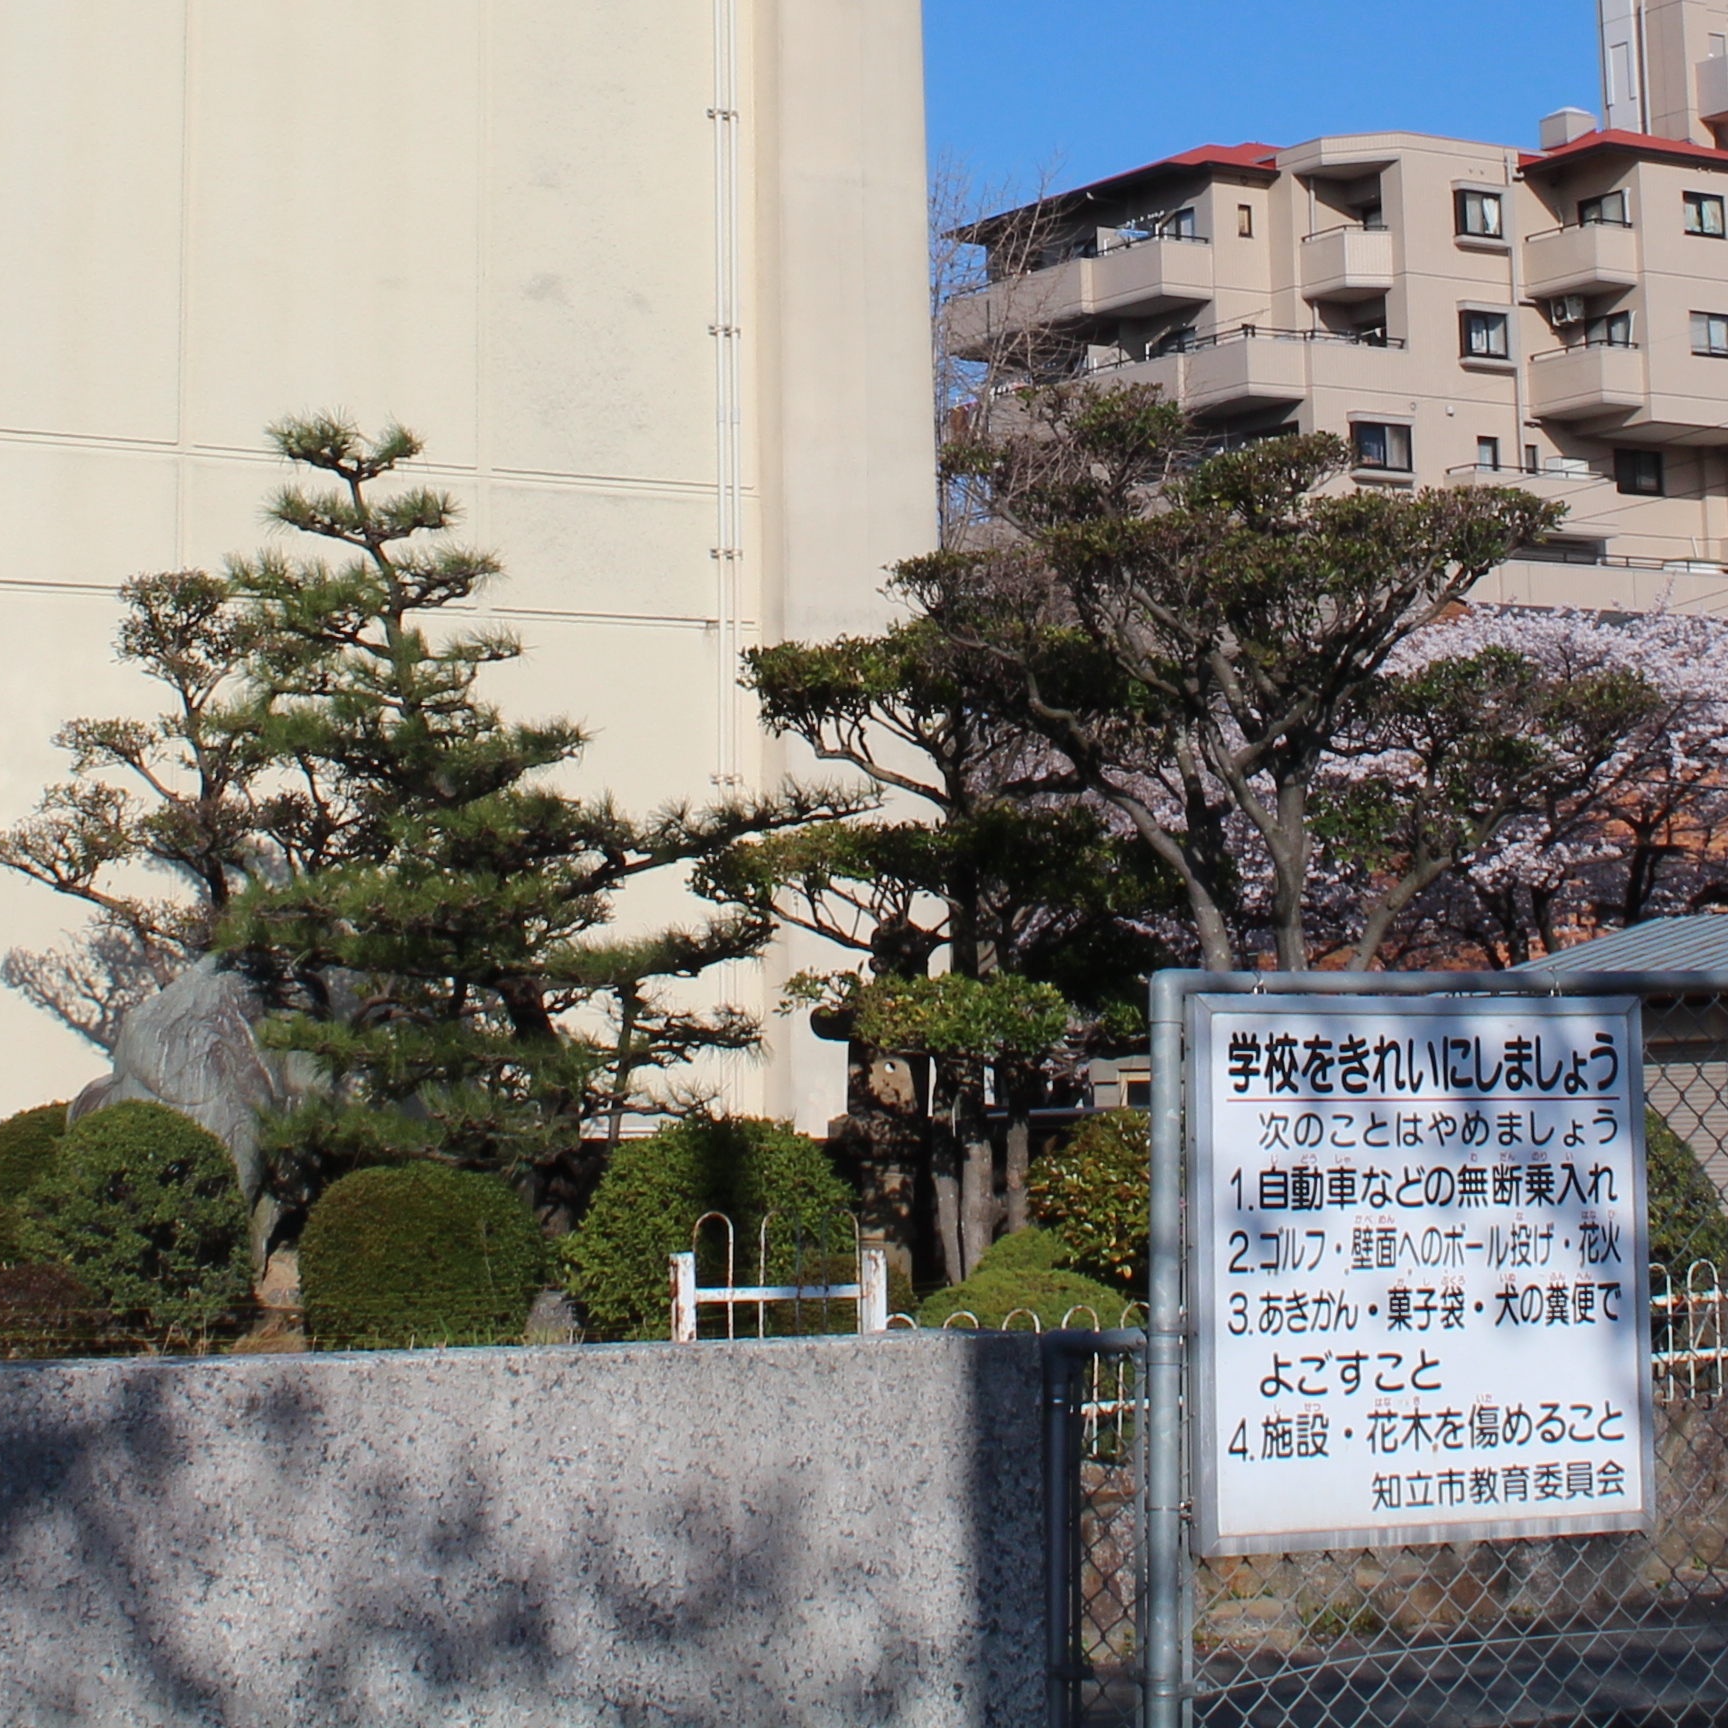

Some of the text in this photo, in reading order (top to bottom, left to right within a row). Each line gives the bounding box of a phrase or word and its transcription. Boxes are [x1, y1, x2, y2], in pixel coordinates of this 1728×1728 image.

[1228, 1032, 1619, 1094] 学校をきれいにしましょう
[1259, 1108, 1618, 1150] 次のことはやめましょう
[1259, 1349, 1442, 1397] よごすこと
[1371, 1459, 1626, 1512] 知立市教育委員会
